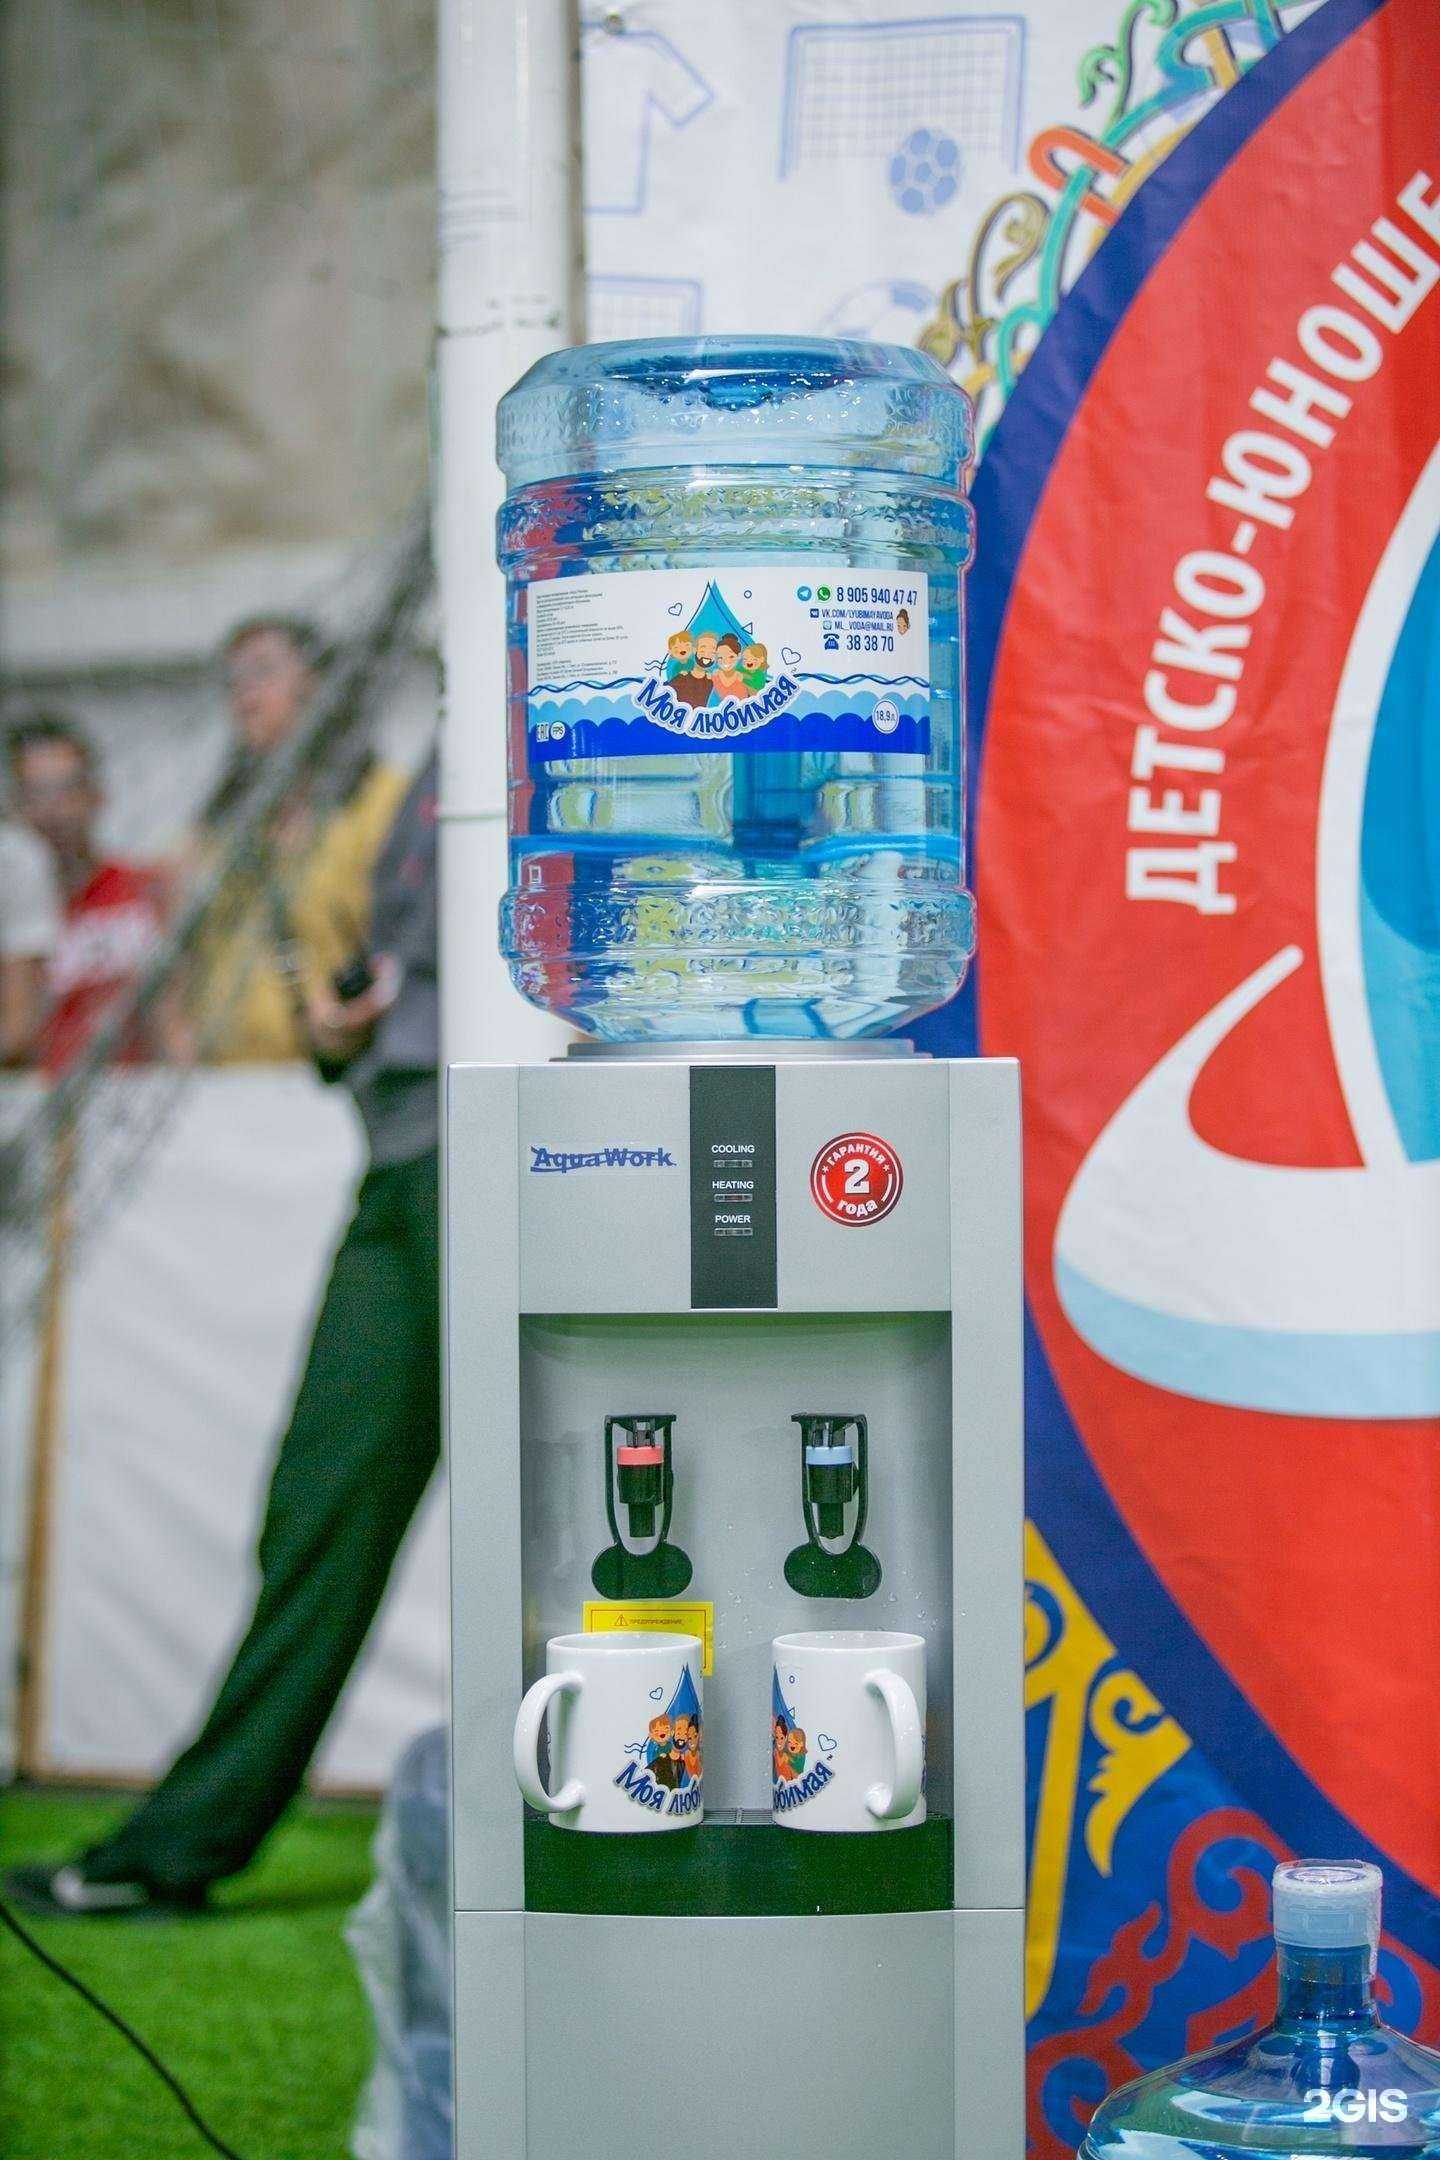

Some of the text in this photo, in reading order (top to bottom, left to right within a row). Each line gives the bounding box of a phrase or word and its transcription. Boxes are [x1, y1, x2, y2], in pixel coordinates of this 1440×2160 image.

[836, 586, 917, 605] 8 905 940 47 47
[846, 635, 894, 652] 38 38 70
[637, 674, 797, 733] Моя любимая
[711, 1144, 755, 1153] COOLING
[827, 1143, 886, 1166] ГАРАНТИЯ
[712, 1181, 754, 1189] HEATING
[844, 1158, 870, 1194] 2
[837, 1199, 878, 1217] года
[715, 1214, 751, 1223] POWER
[616, 1761, 702, 1813] Моя люб
